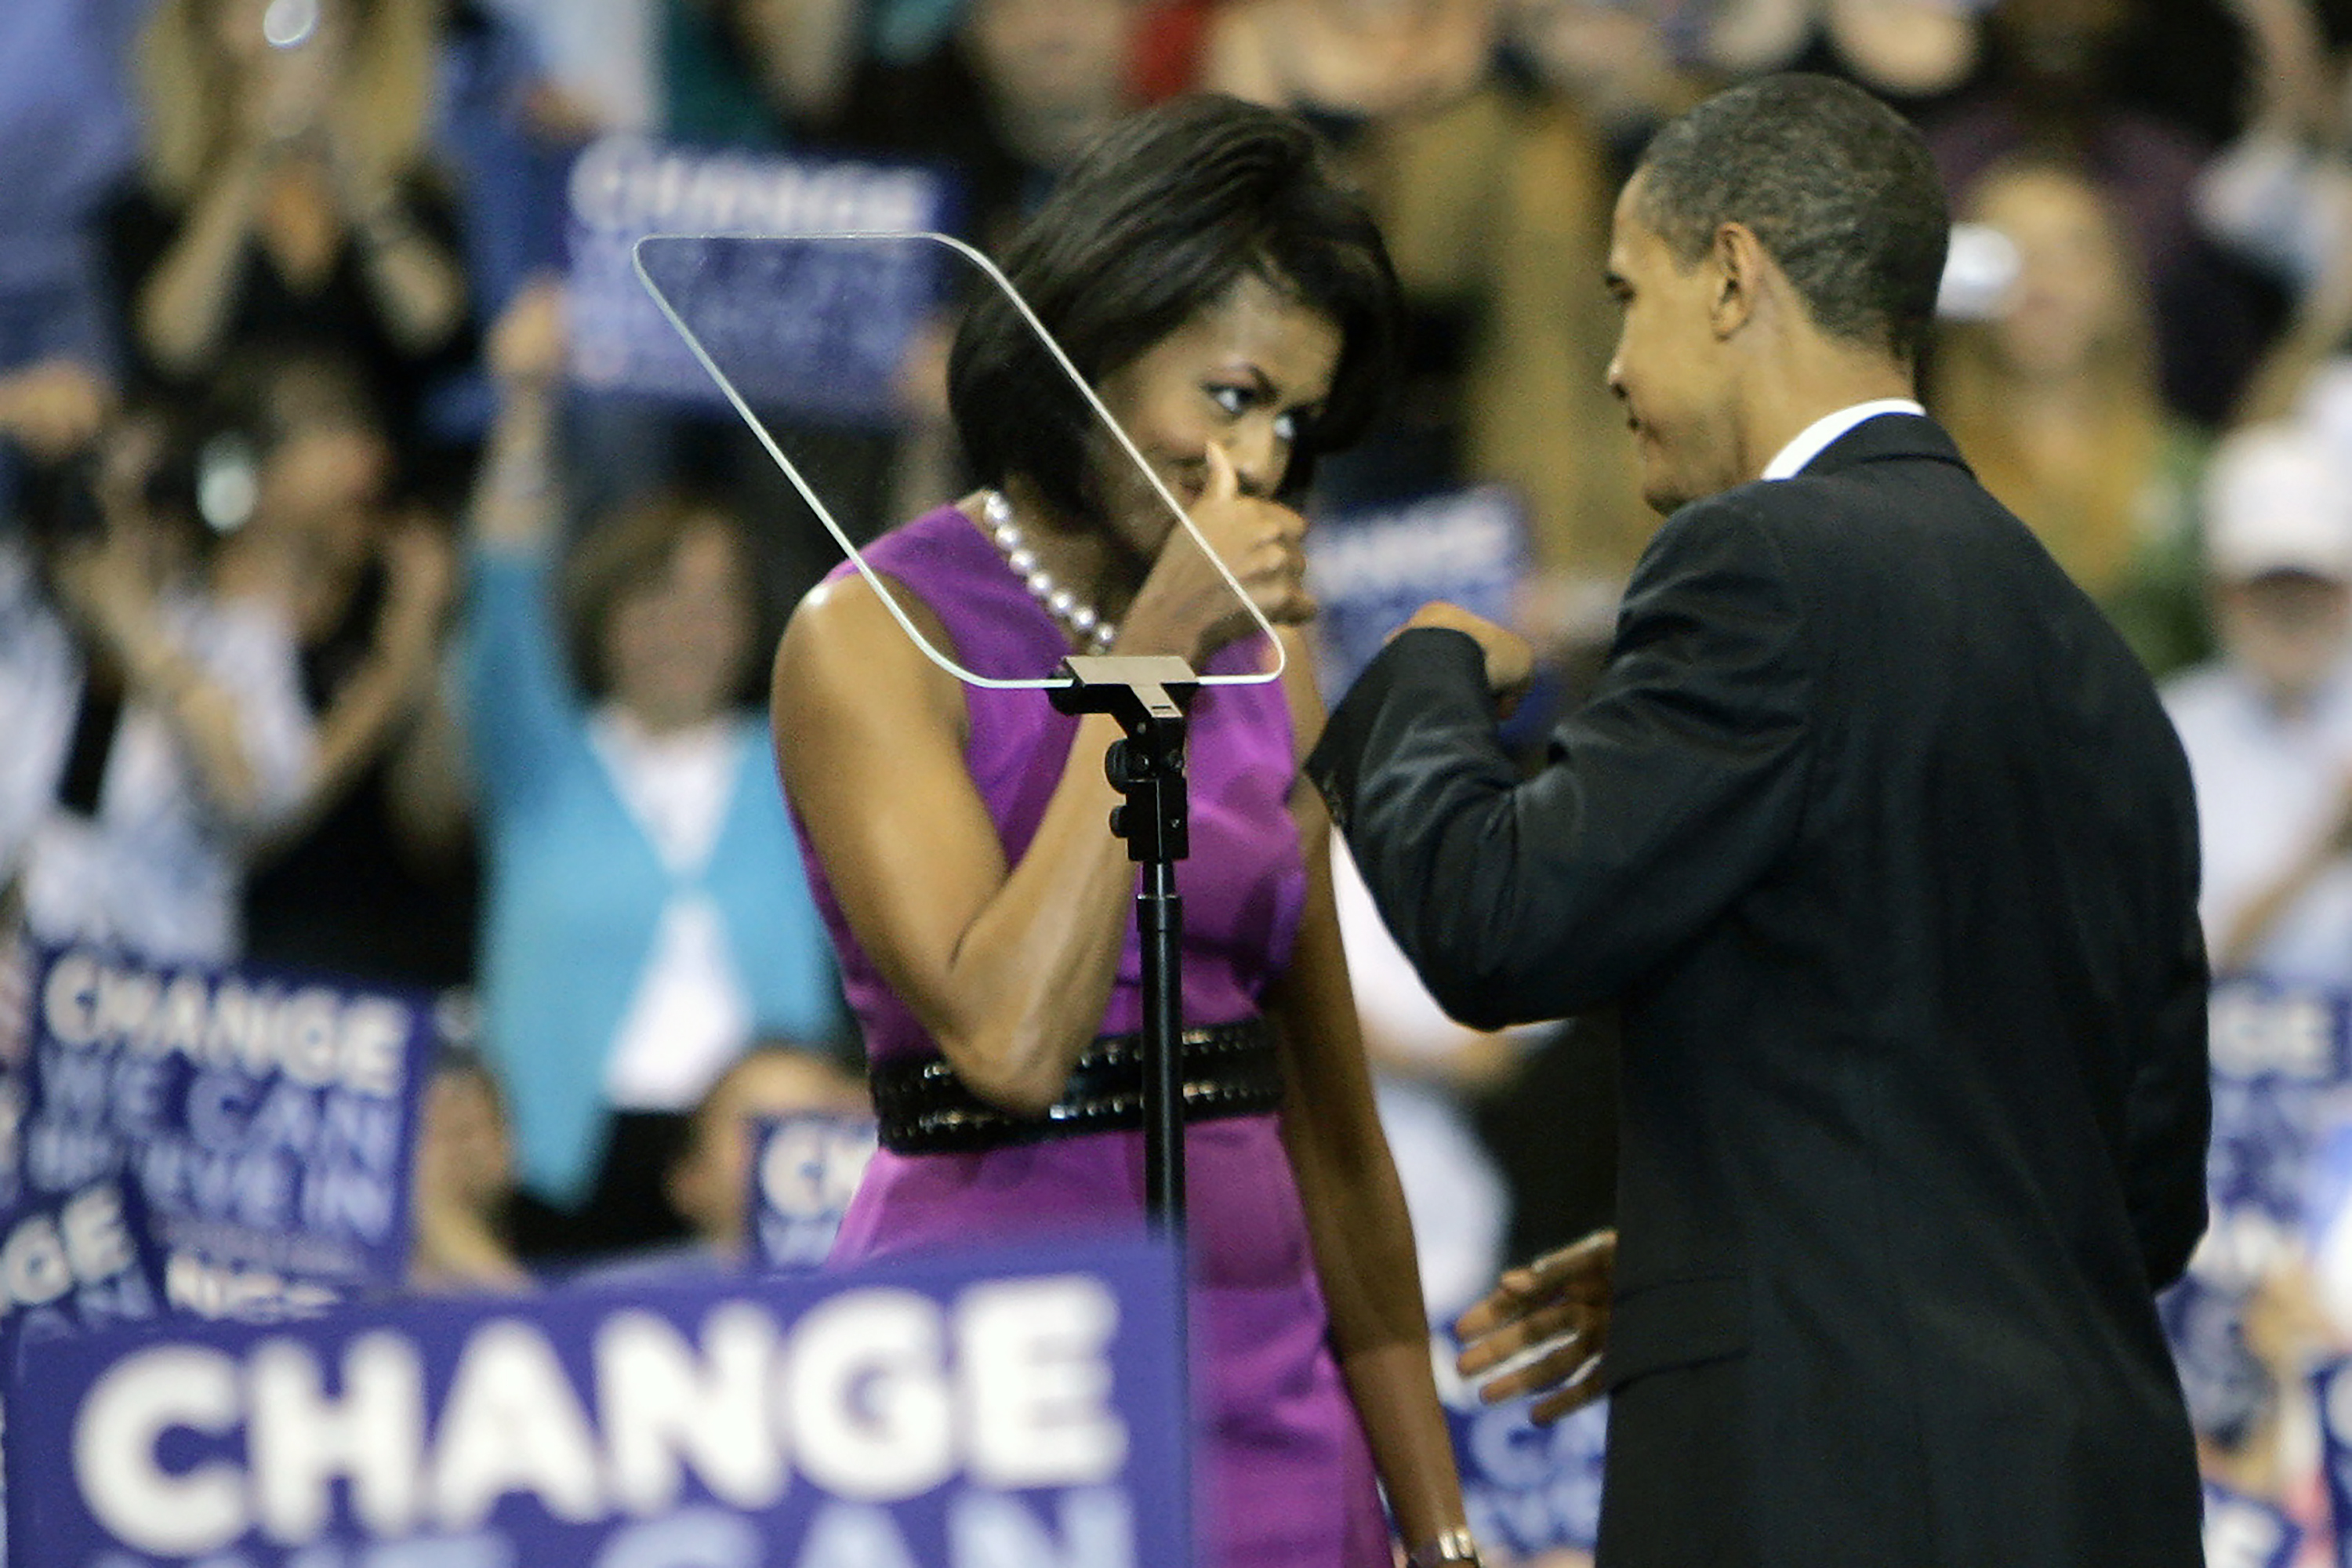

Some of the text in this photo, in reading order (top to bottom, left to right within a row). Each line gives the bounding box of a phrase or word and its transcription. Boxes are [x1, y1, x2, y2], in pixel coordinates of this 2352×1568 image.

[45, 950, 409, 1098] CHANGE
[185, 1068, 398, 1178] CAN
[0, 1180, 135, 1316] GE
[71, 1270, 1131, 1559] CHANGE
